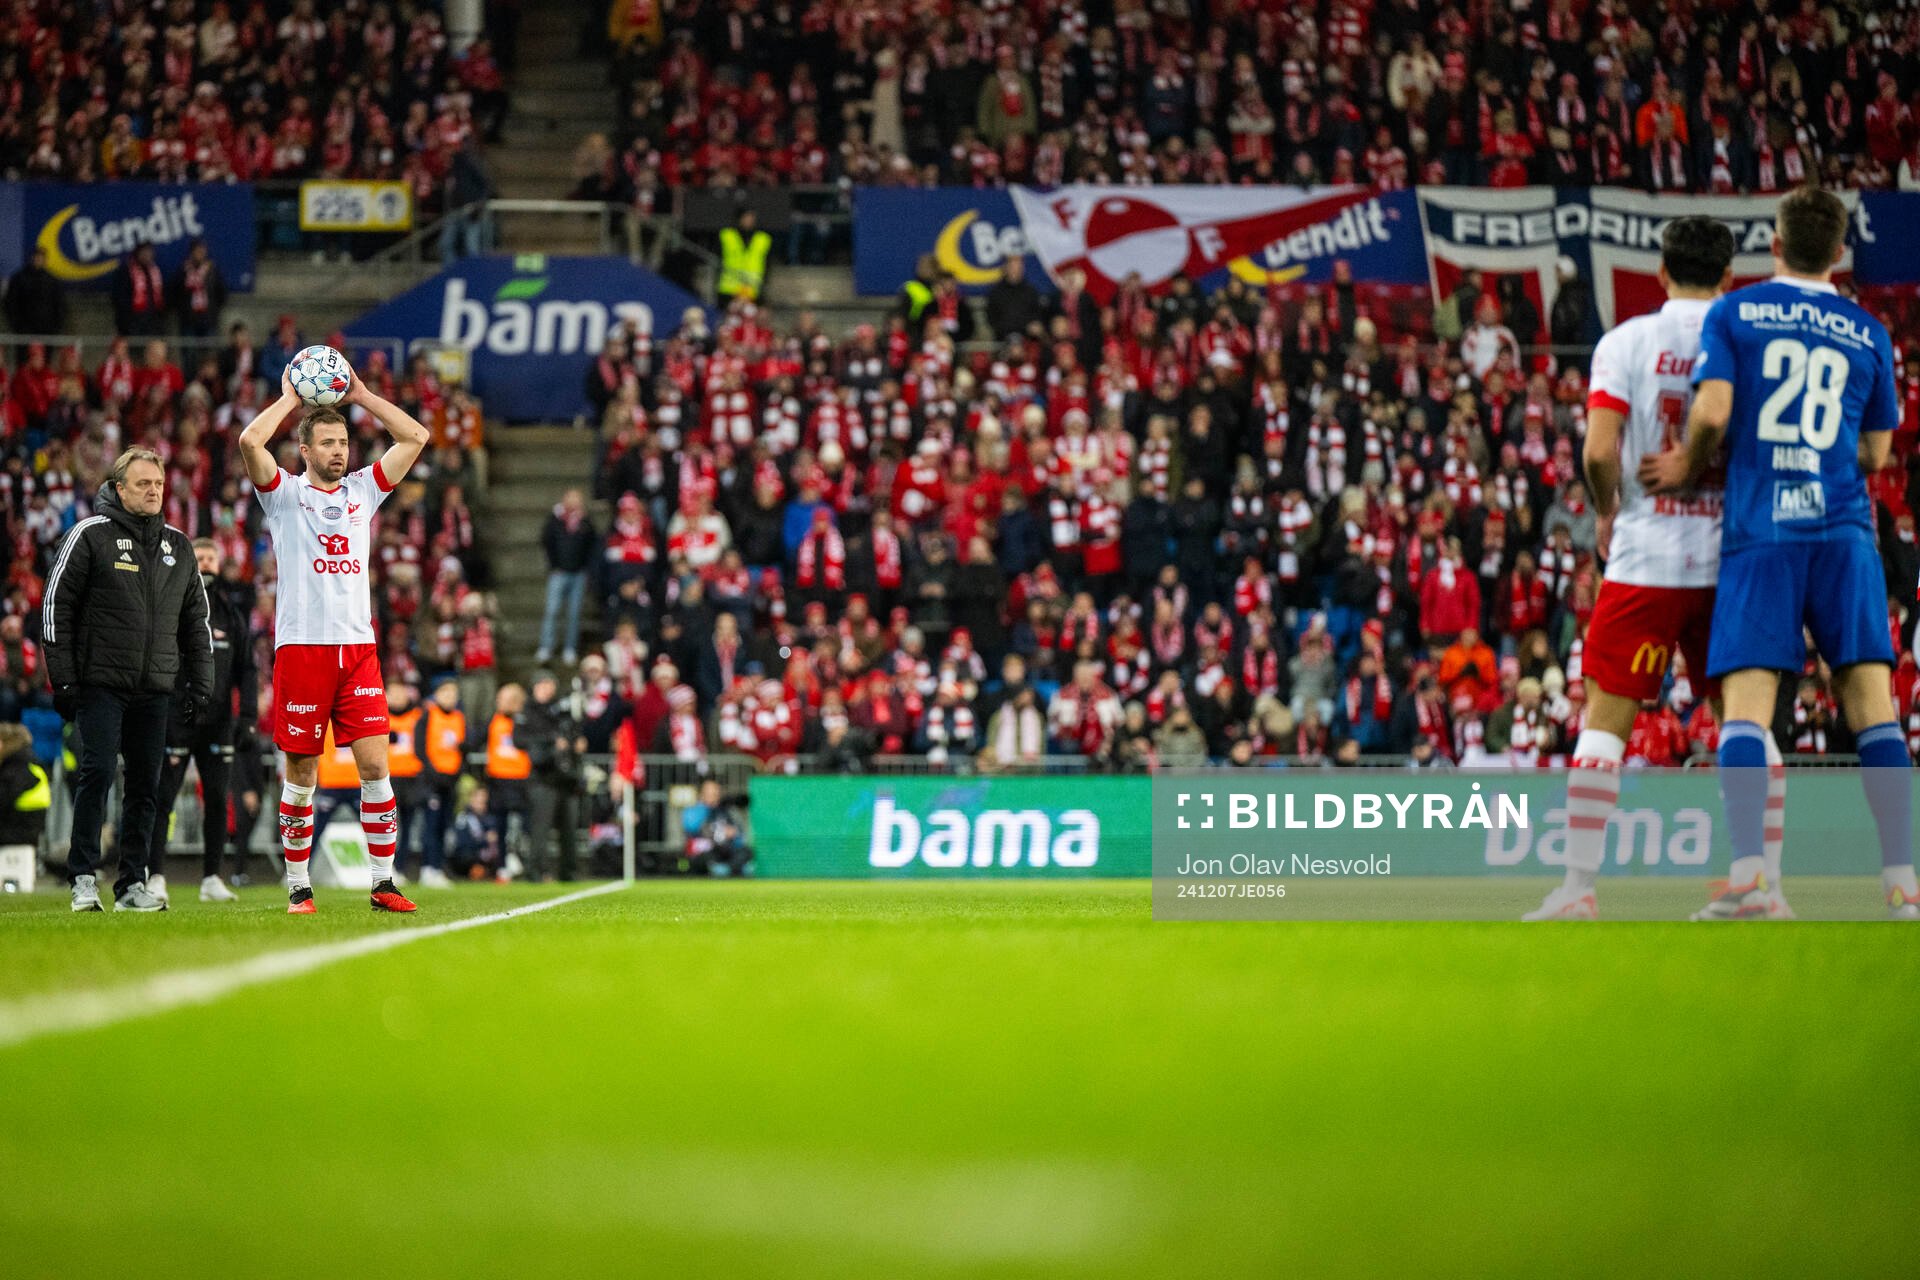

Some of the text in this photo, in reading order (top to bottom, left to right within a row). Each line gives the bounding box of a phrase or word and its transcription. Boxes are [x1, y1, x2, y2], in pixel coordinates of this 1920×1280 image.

[71, 192, 204, 262] Bendit
[1194, 226, 1227, 262] F
[439, 277, 654, 355] bama
[1739, 301, 1875, 349] BRUNVOLL
[1757, 338, 1850, 450] 28
[313, 559, 361, 575] OBOS
[315, 724, 322, 739] 5
[869, 798, 1101, 867] bama
